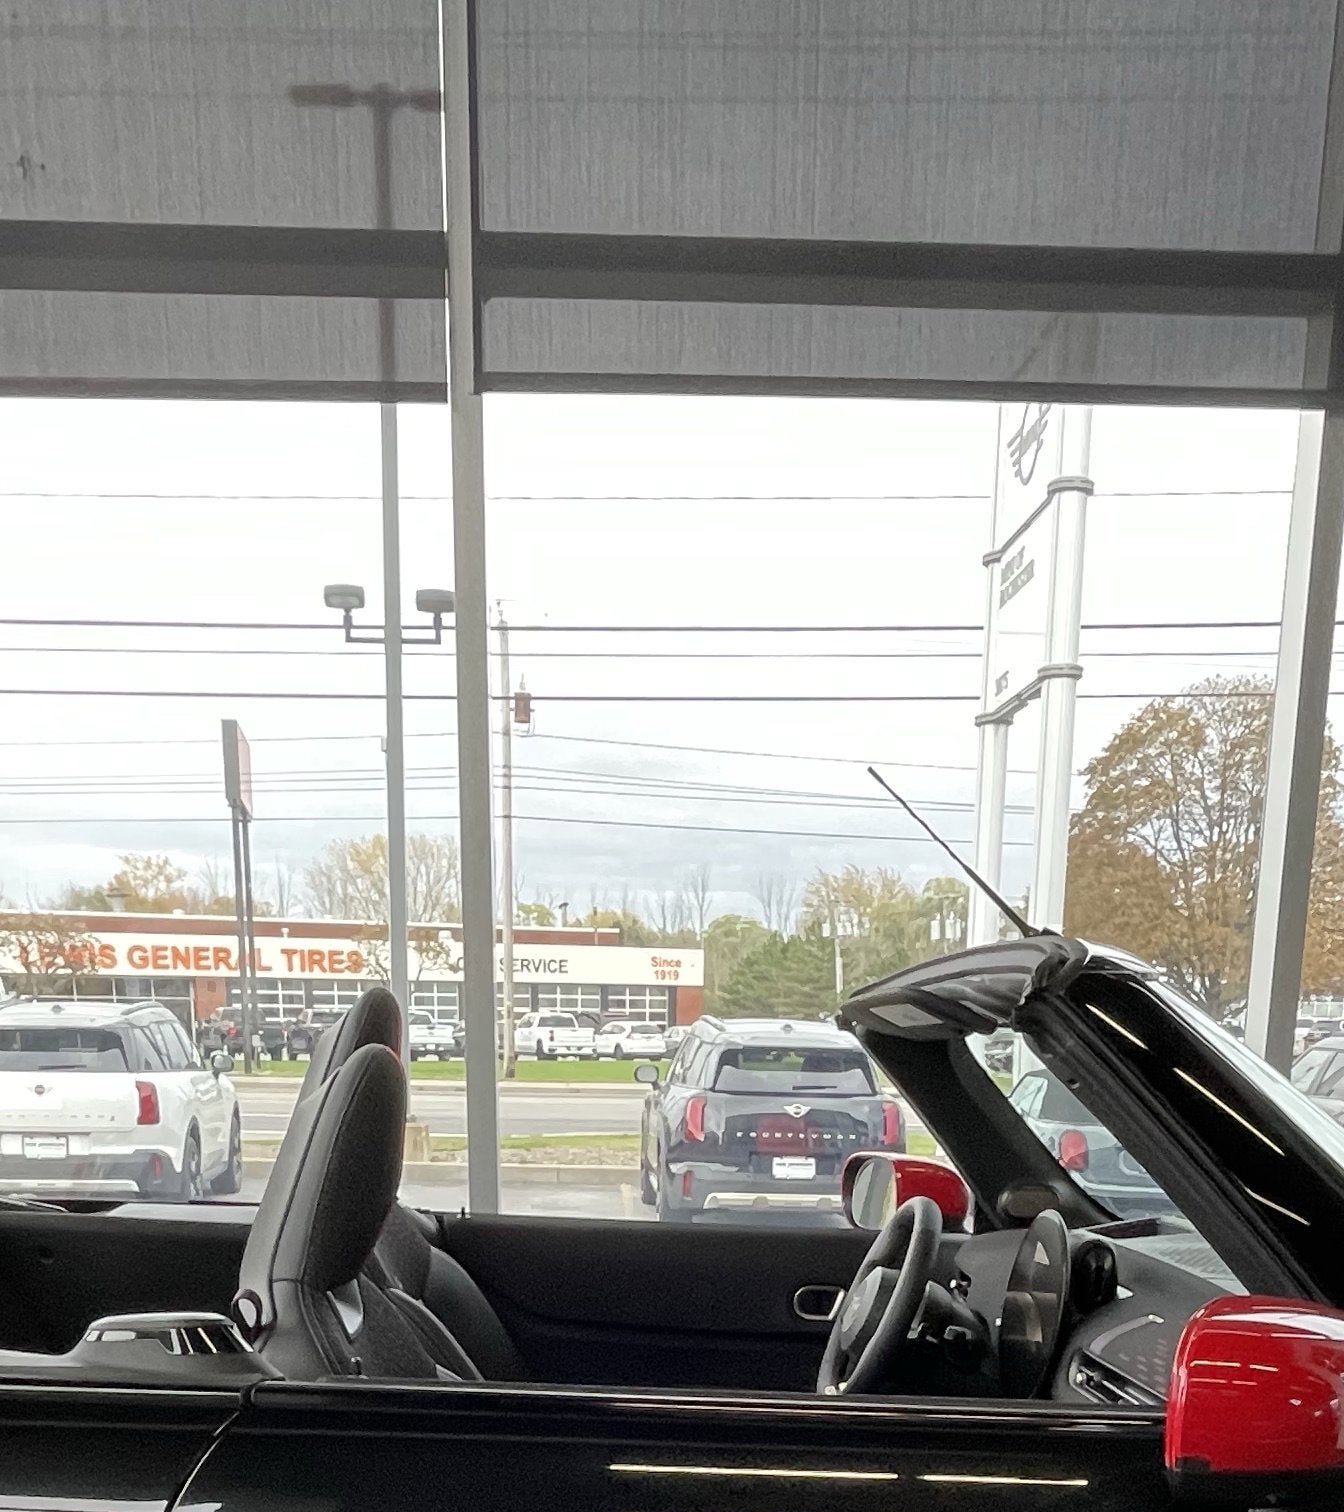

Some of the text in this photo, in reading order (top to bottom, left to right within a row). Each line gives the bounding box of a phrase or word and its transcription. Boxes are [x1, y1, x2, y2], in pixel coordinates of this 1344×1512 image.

[280, 948, 364, 974] TIRES
[651, 956, 681, 968] Since
[654, 969, 680, 981] 1919
